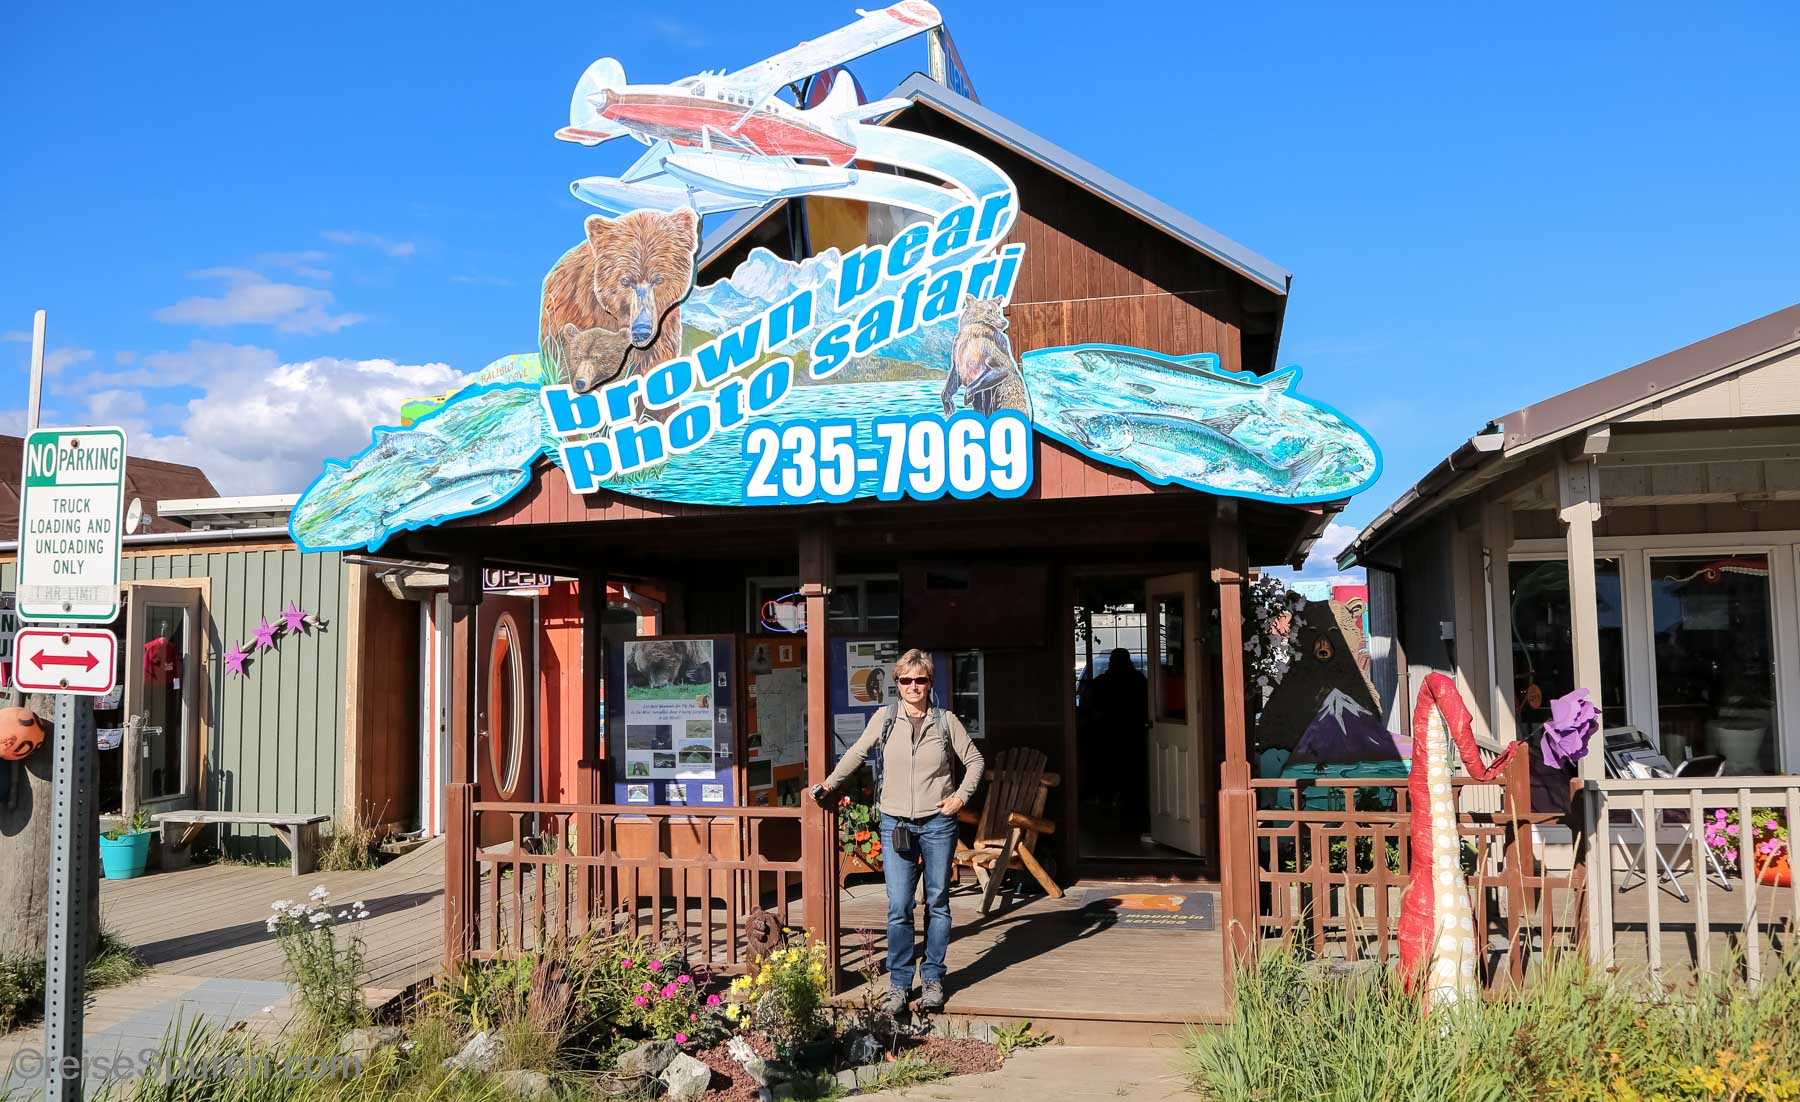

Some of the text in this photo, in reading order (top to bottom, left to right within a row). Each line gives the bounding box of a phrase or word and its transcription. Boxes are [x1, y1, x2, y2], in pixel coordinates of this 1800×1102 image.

[545, 192, 1012, 433] brown bear
[480, 361, 515, 384] HALIBUT
[563, 247, 1022, 490] photo safari
[27, 442, 118, 477] NO PARKING
[746, 416, 1027, 498] 235-7969
[53, 498, 91, 513] TRUCK
[30, 518, 111, 534] LOADING AND
[35, 539, 104, 554] UNLOADING
[53, 559, 85, 575] ONLY
[485, 567, 548, 587] OPEN
